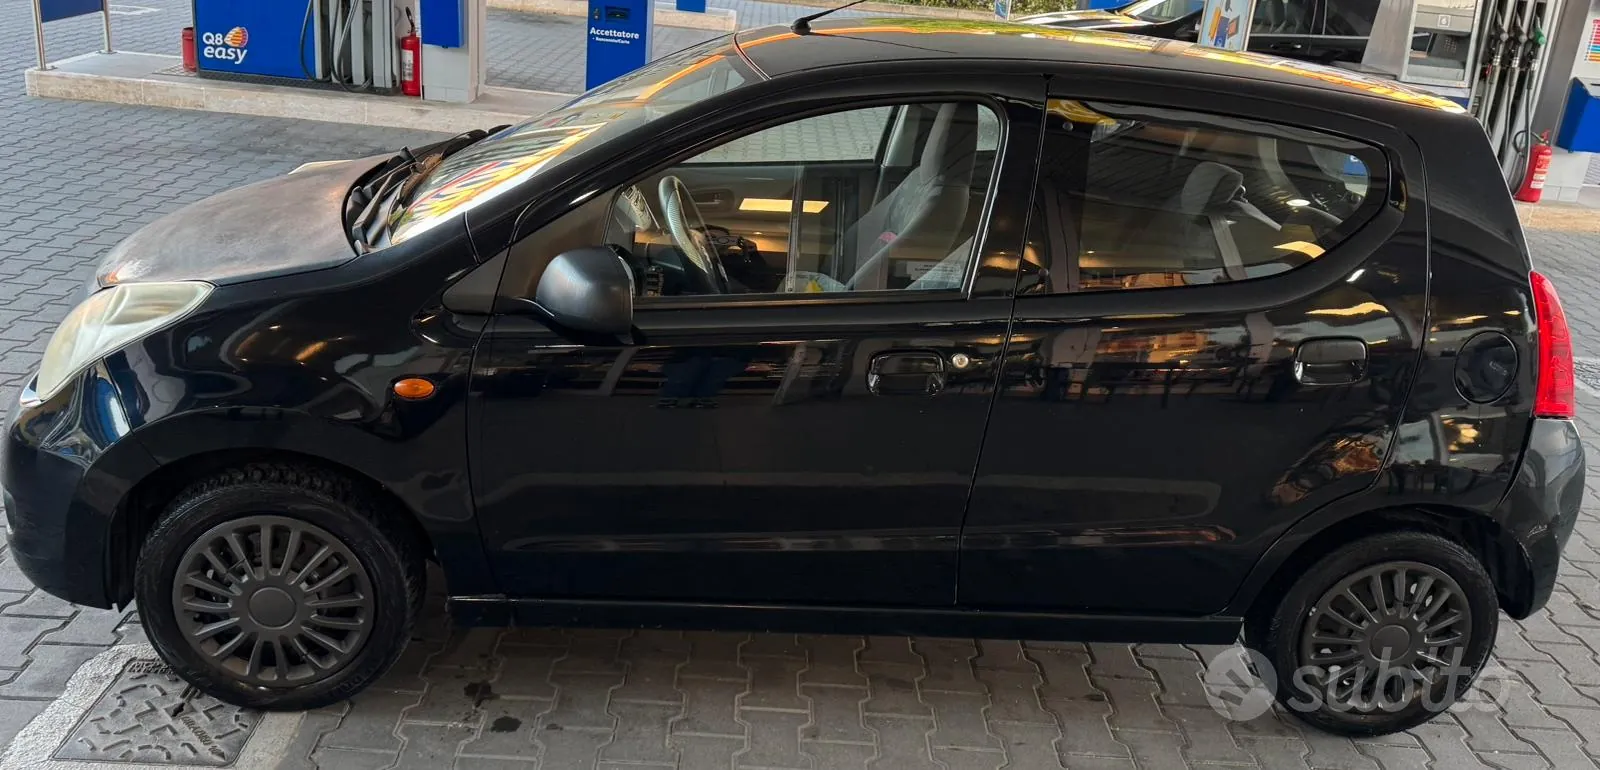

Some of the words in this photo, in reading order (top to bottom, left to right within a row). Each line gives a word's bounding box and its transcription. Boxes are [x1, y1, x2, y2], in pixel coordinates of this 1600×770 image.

[202, 32, 223, 45] Q8
[590, 27, 639, 39] Accettatore
[203, 45, 248, 65] easy
